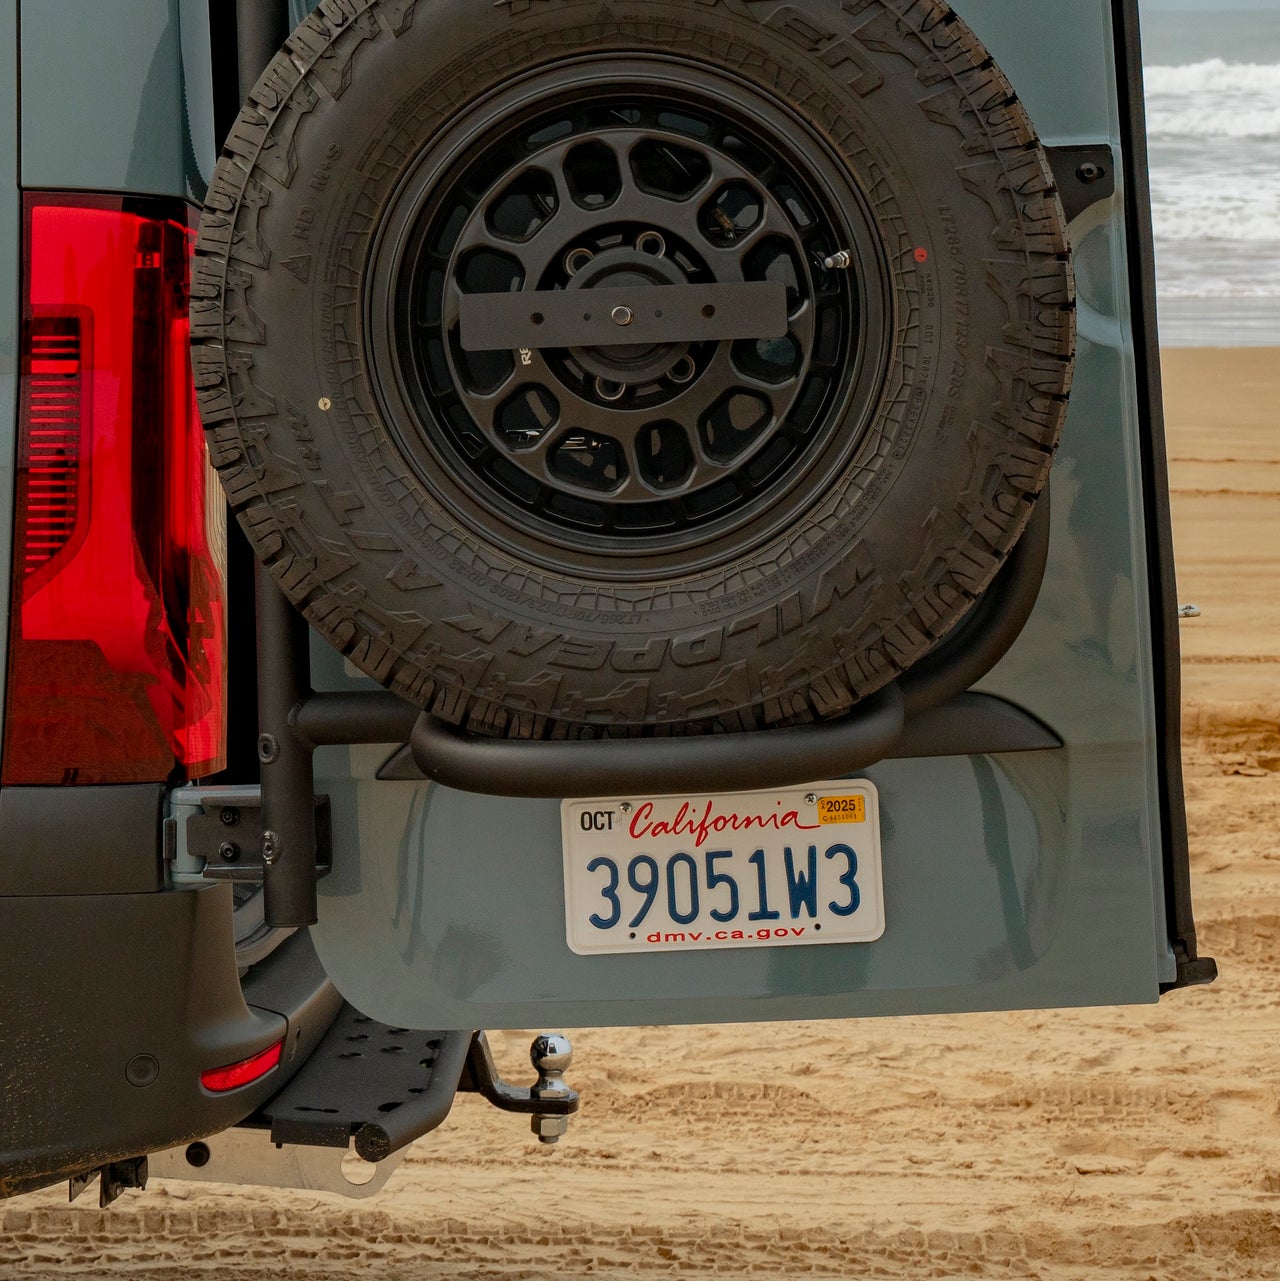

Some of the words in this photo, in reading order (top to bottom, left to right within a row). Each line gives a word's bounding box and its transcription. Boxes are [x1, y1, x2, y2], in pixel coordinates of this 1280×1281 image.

[440, 537, 875, 673] WILDPEAK
[580, 810, 615, 831] OCT
[826, 799, 856, 813] 2025
[628, 800, 821, 847] California
[586, 843, 861, 929] 39051W3
[646, 926, 806, 943] dmv.ca.gov
